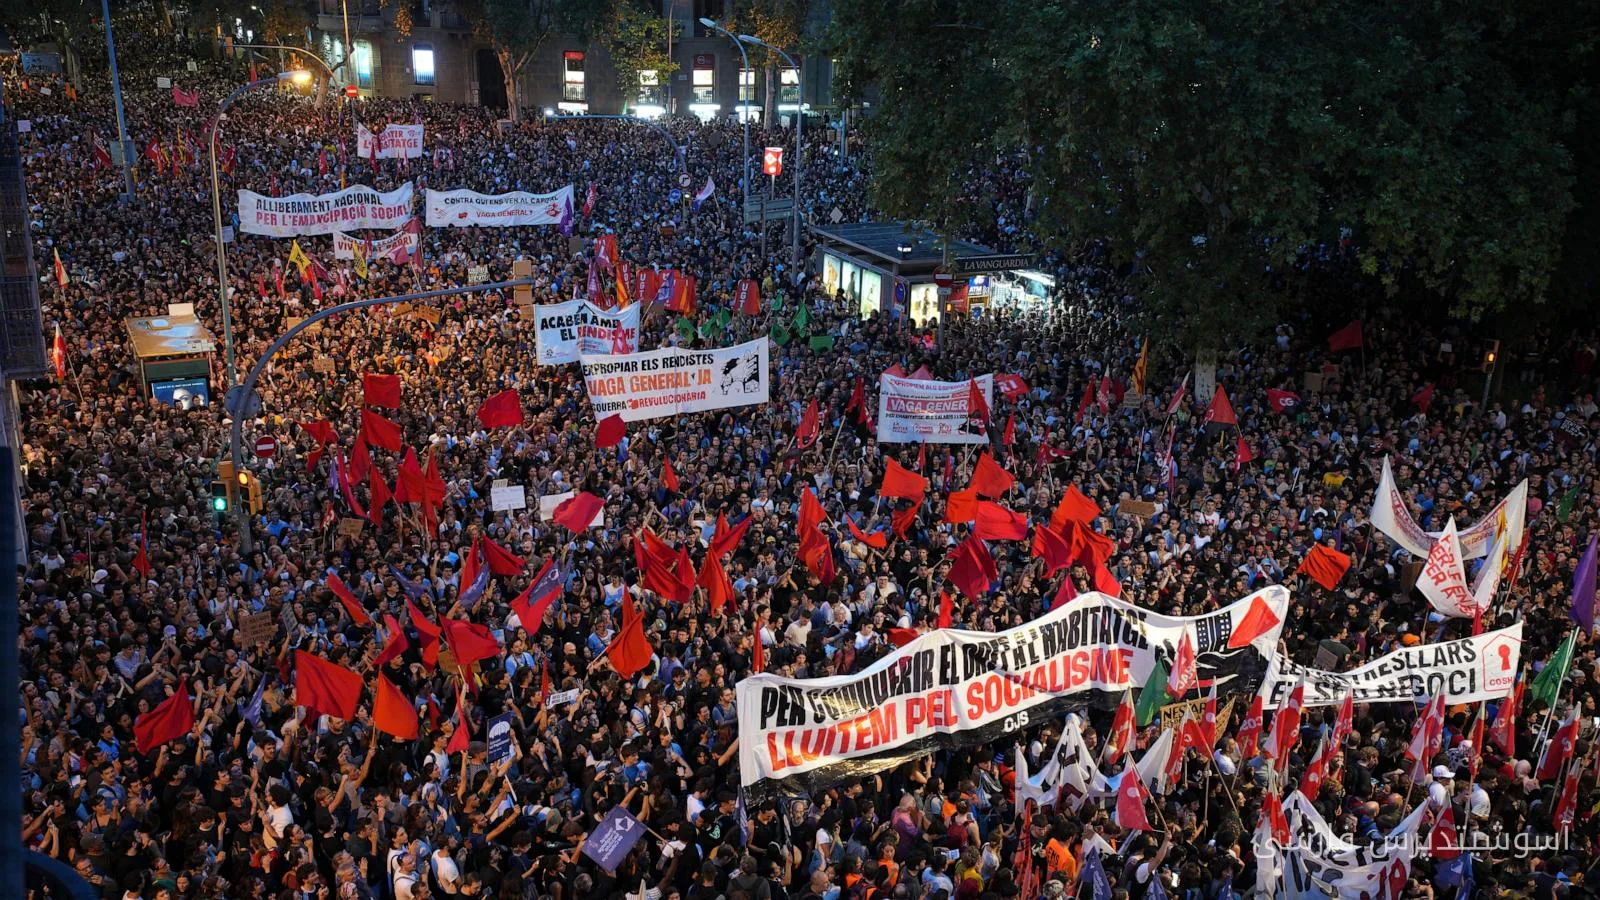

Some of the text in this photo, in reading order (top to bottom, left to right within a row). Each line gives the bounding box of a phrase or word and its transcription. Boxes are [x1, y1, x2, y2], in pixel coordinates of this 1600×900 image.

[256, 192, 383, 213] ALLIBERAMENT NACIONAL
[444, 197, 473, 205] CONTRA
[256, 211, 278, 226] PER
[476, 210, 496, 218] VAGA
[964, 258, 1029, 270] LA VANGUARDIA
[639, 273, 647, 297] UGT
[560, 329, 576, 341] EL
[641, 358, 659, 371] ELS
[662, 353, 714, 369] RENDISTES
[587, 376, 626, 397] VAGA
[629, 371, 691, 393] GENERAL
[890, 399, 968, 412] VAGA GENER
[761, 685, 807, 730] PER
[939, 645, 959, 685] EL
[768, 702, 898, 772] LLUITEM
[906, 690, 958, 734] PEL
[966, 648, 1134, 721] SOCIALISME
